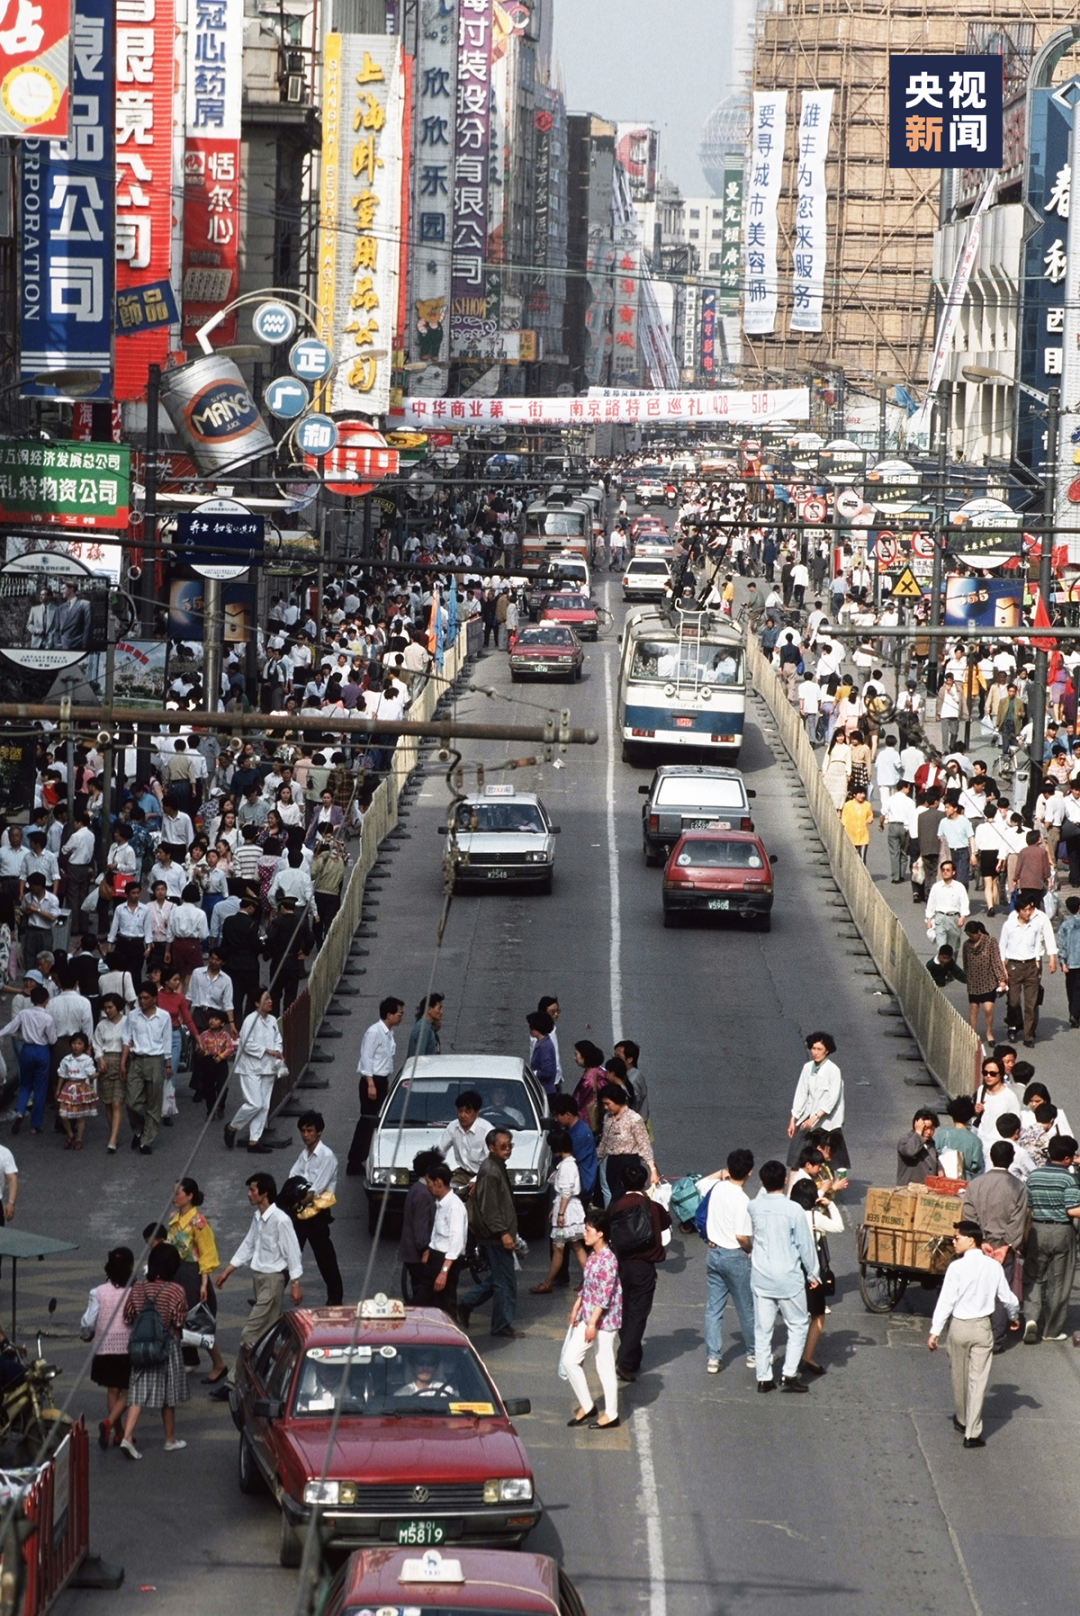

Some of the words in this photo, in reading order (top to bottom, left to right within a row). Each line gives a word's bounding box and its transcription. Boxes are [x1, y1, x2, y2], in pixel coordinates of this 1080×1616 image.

[326, 59, 338, 160] SHANGHAI
[420, 66, 451, 242] 欣欣乐园
[297, 347, 327, 374] 正
[272, 386, 302, 410] 广
[303, 423, 332, 448] 和
[399, 1527, 444, 1544] M5819
